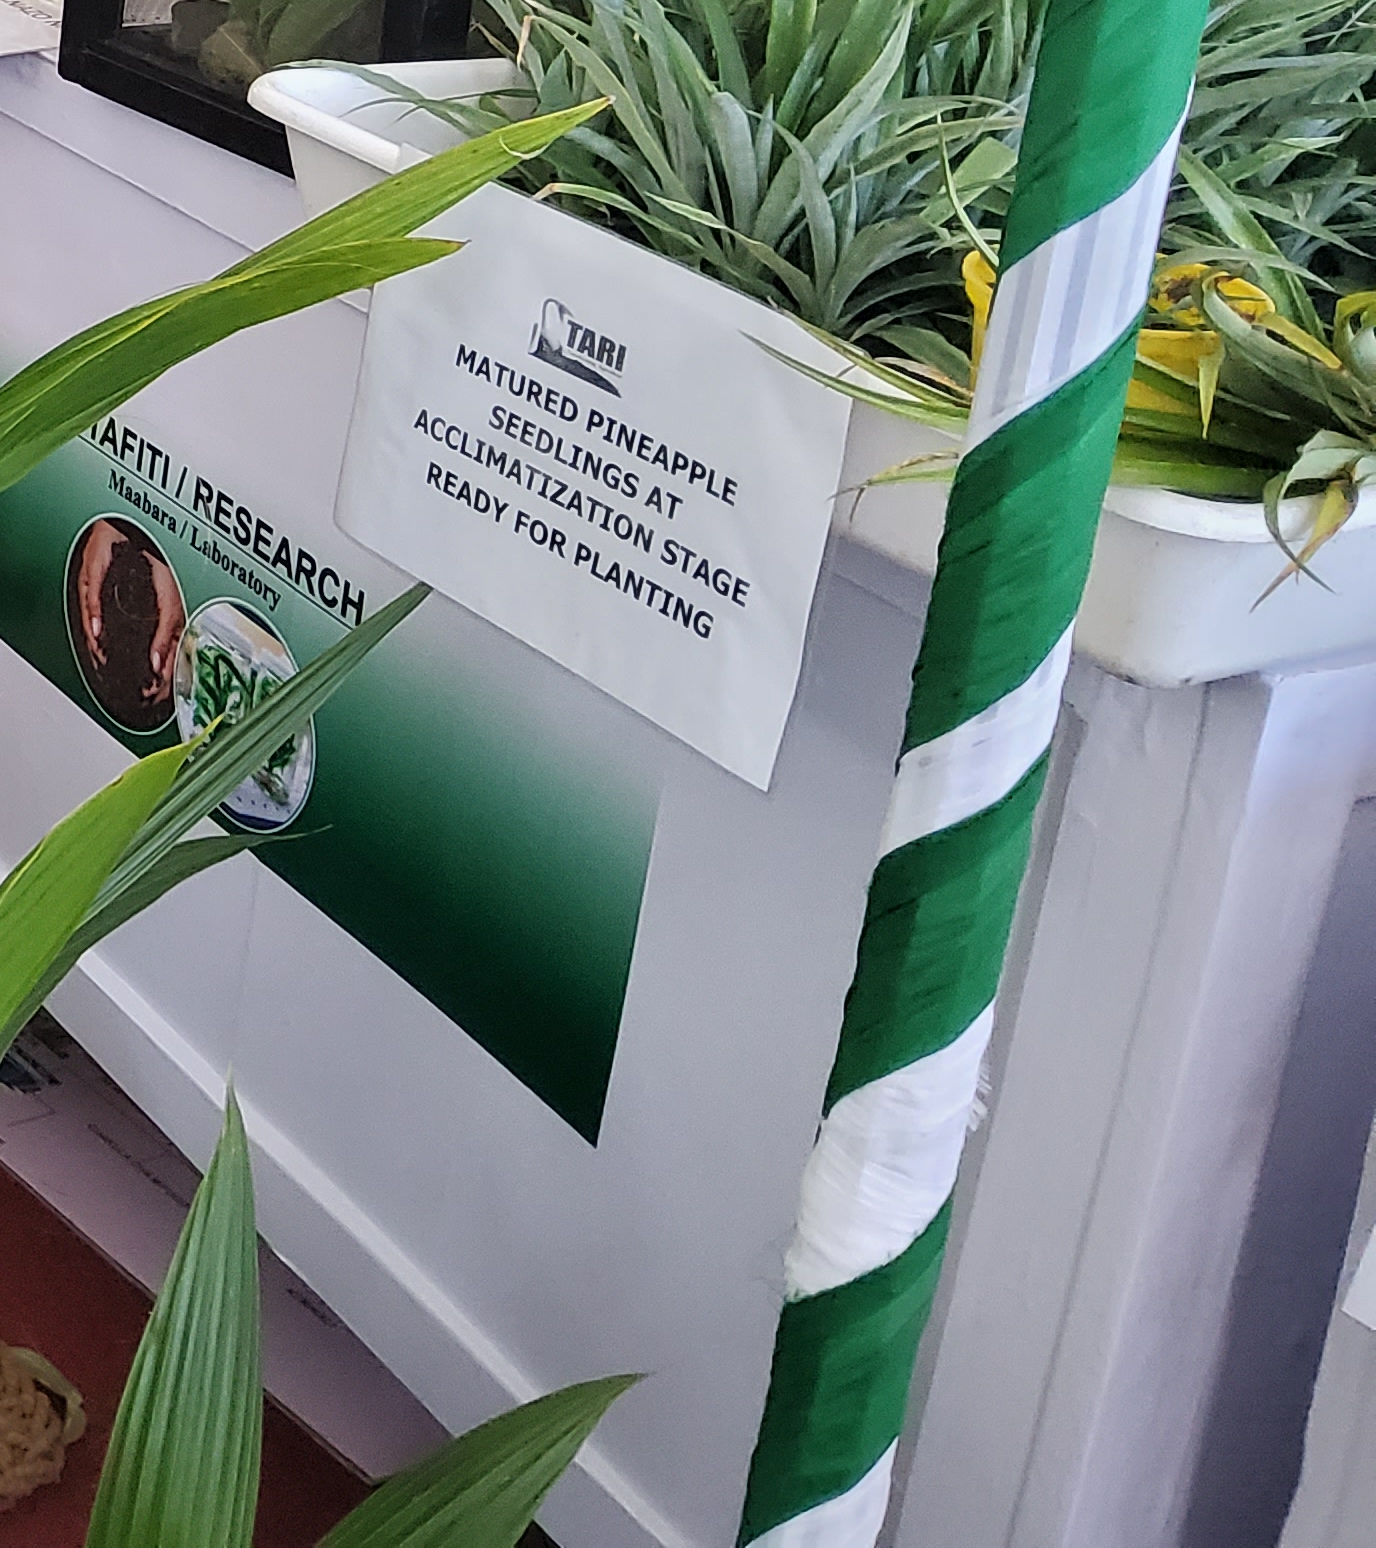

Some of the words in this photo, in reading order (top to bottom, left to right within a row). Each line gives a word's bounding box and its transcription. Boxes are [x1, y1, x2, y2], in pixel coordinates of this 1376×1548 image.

[455, 343, 580, 423] MATURED
[586, 408, 739, 506] PINEAPPLE
[566, 319, 628, 372] TARI
[91, 416, 170, 490] AFITI
[193, 475, 365, 626] RESEARCH
[107, 468, 177, 534] Maabara
[190, 527, 282, 612] Laboratory
[414, 408, 655, 553] ACCLIMATIZATION
[660, 539, 750, 607] STAGE
[488, 405, 640, 499] SEEDLINGS
[644, 486, 683, 520] AT
[425, 461, 509, 523] READY
[514, 511, 566, 557] FOR
[573, 542, 714, 639] PLANTING
